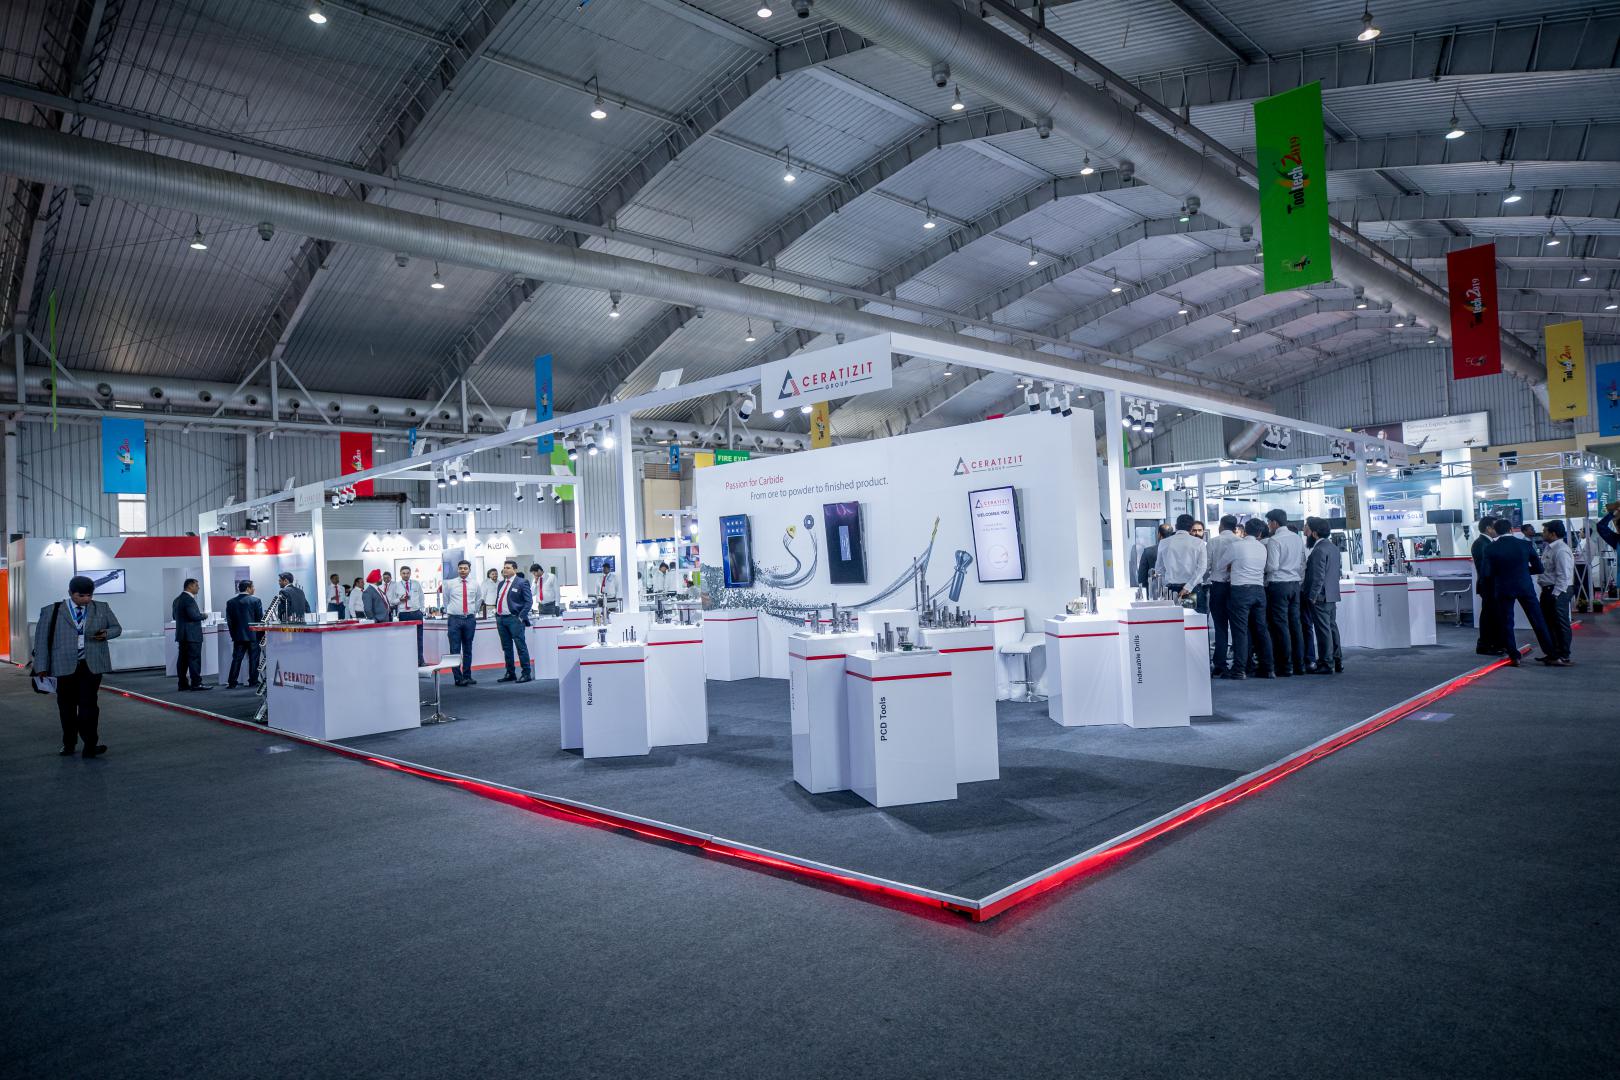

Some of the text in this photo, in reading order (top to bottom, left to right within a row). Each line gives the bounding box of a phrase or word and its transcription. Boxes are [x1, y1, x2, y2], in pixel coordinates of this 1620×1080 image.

[802, 362, 873, 387] CERATIZIT
[825, 380, 849, 390] GROUP
[971, 455, 1023, 469] CERATIZIT
[725, 474, 784, 490] Passion for Carbide
[750, 476, 889, 500] From ore to powder to finished product.
[1133, 634, 1141, 652] Drills
[283, 671, 315, 685] CERATIZIT
[879, 696, 888, 741] PCD Tools
